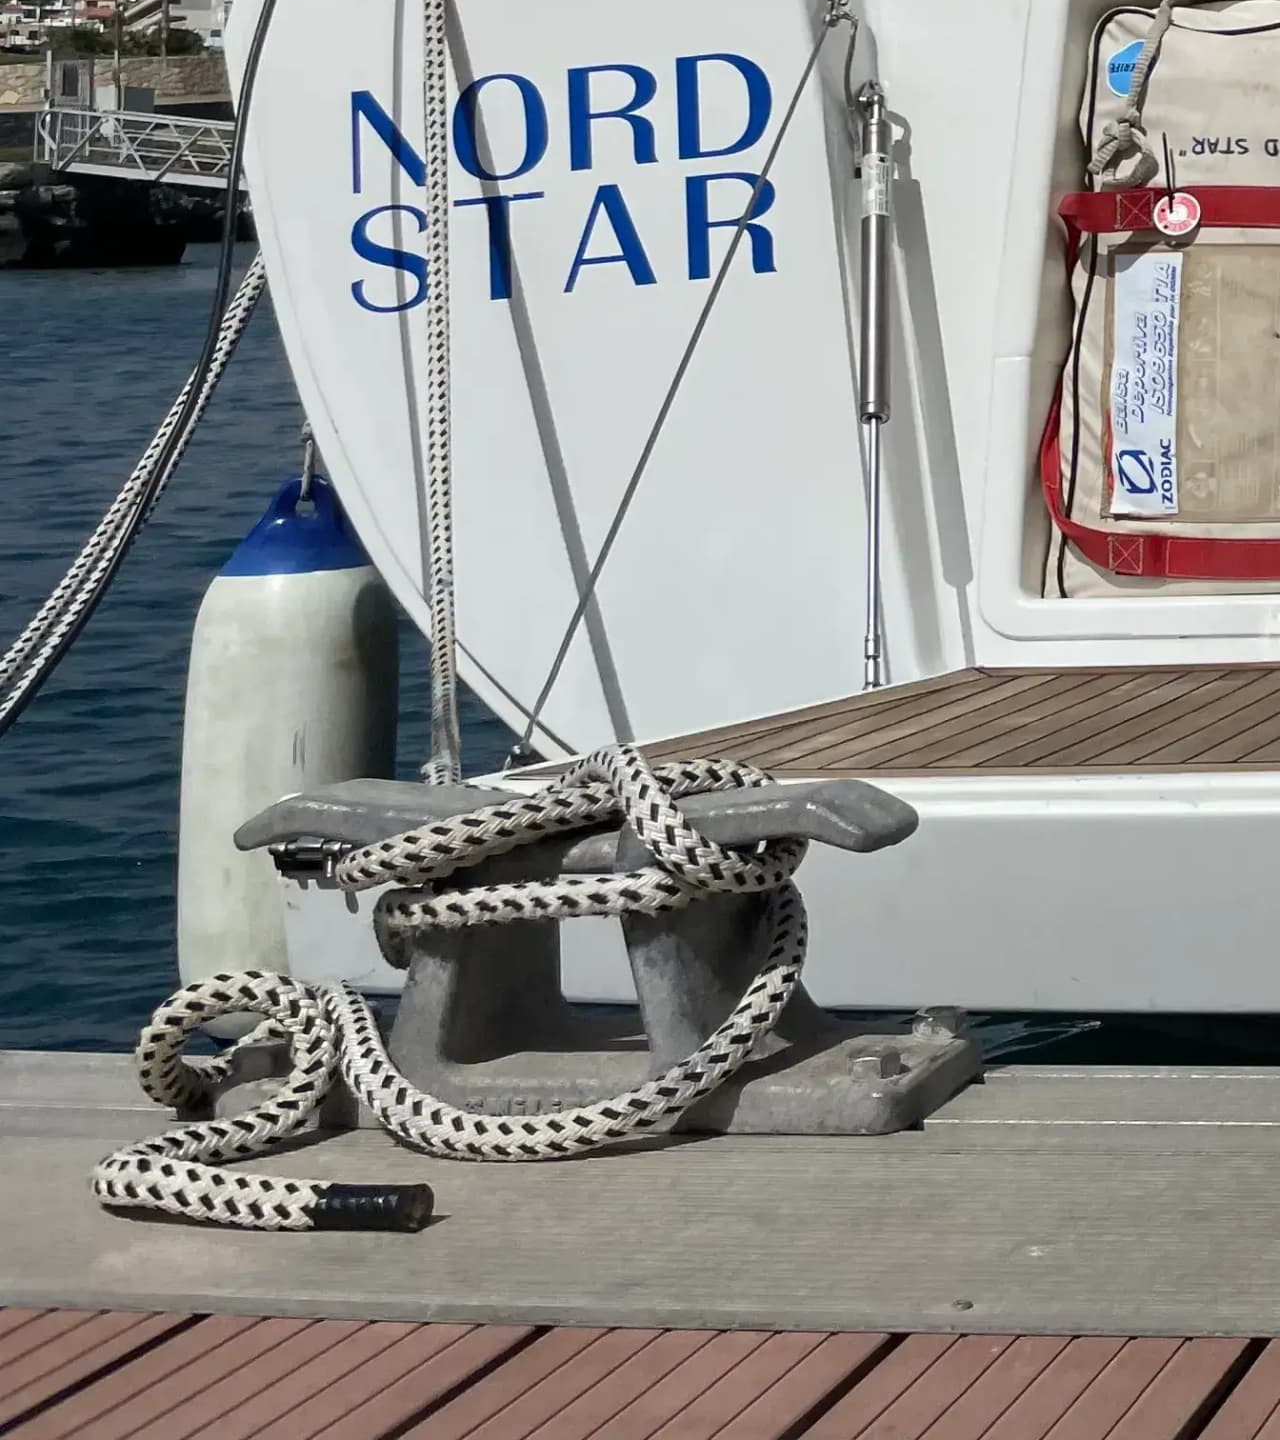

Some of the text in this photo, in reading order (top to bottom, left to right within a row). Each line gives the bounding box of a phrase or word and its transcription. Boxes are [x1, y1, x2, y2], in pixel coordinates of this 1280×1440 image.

[350, 52, 773, 195] NORD
[350, 172, 778, 314] STAR
[1160, 438, 1175, 505] ZODIAC
